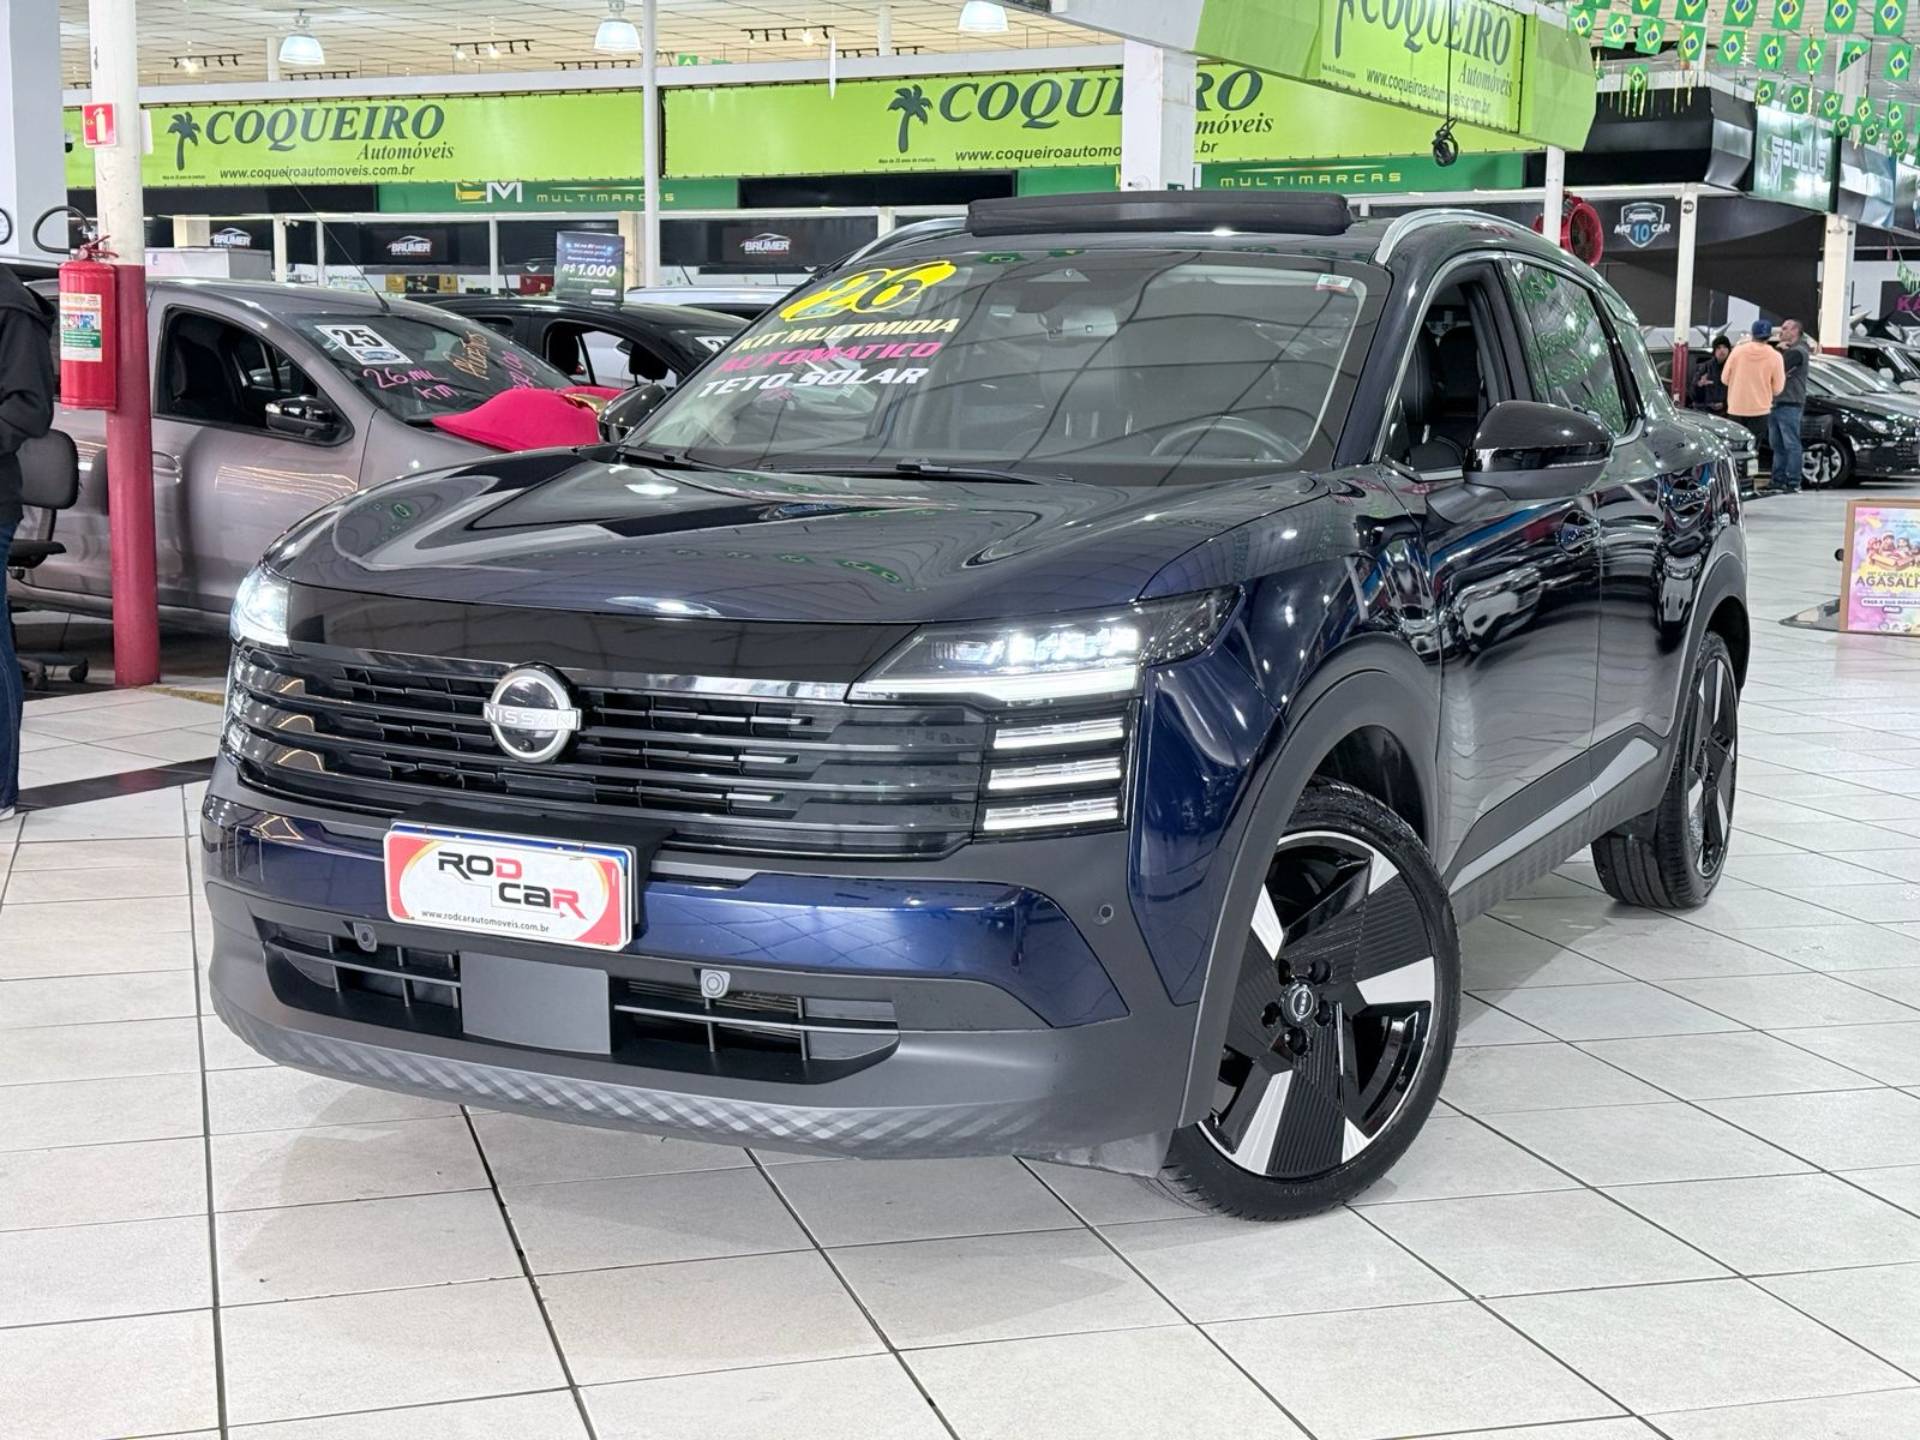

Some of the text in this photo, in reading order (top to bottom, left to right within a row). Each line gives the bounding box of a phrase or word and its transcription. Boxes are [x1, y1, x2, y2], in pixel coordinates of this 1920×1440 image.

[1366, 67, 1491, 114] www.coqueiroautomveis.com.br
[1458, 60, 1514, 98] Automóveis
[939, 69, 1263, 130] COQUO
[205, 104, 445, 152] COQUEIRO
[1194, 112, 1274, 136] móveis
[357, 141, 455, 161] Automóveis
[954, 141, 1218, 162] www.coqueiroautomo.br
[1782, 139, 1826, 177] SOLUS
[219, 164, 415, 181] www.coqueiroautomoveis.com.br
[1220, 172, 1401, 188] MULTIMARCAS
[536, 193, 674, 203] MULTIMARCS
[1633, 223, 1650, 242] 10
[1650, 223, 1671, 233] CAR
[779, 260, 957, 322] 26
[331, 329, 384, 348] 25
[731, 330, 782, 353] KIT
[781, 317, 960, 345] MULTIMIDIA
[719, 341, 943, 373] AUTOMATICO
[363, 366, 409, 389] 26
[697, 367, 930, 399] TETO SOLAR
[484, 705, 574, 729] NISSAN
[438, 851, 522, 881] ROD
[421, 910, 550, 933] www.rodcarautomoveis.com.br
